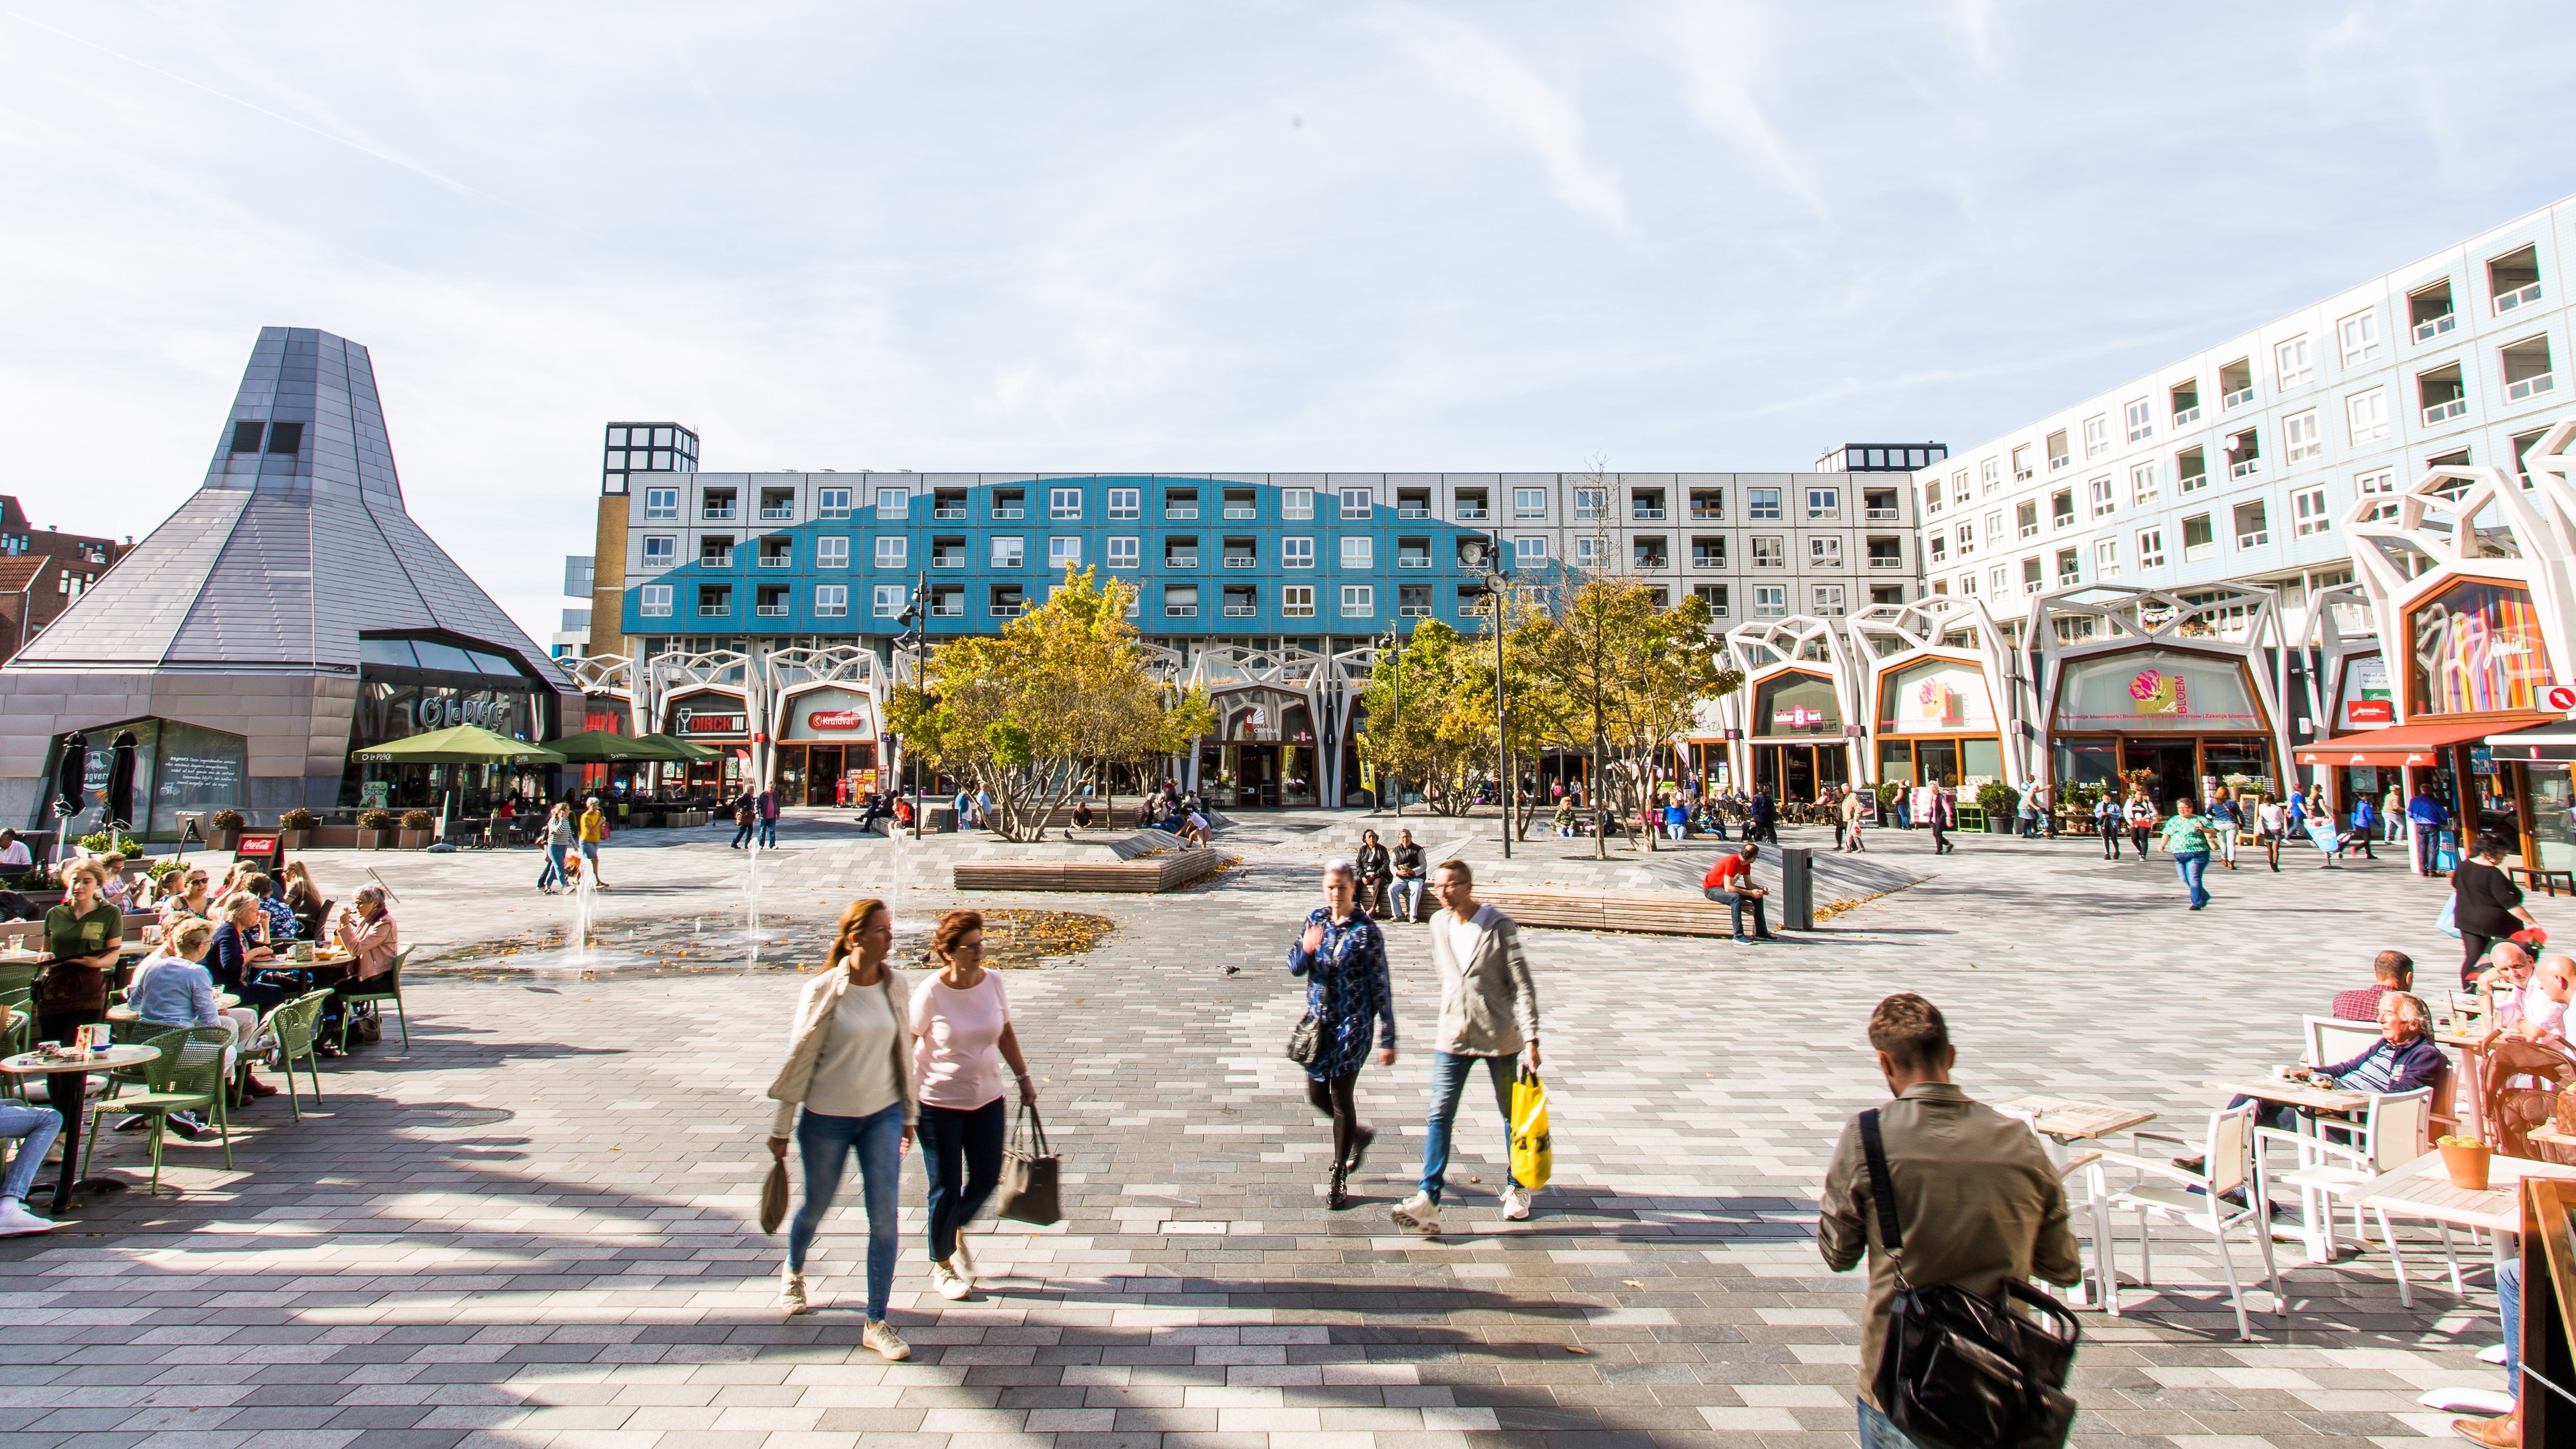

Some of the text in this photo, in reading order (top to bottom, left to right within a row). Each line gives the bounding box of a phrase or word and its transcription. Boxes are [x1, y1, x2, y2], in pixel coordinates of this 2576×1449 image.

[2483, 637, 2534, 670] jamin
[2175, 676, 2187, 714] BLOEM
[443, 699, 503, 732] La PLACE
[822, 716, 854, 725] Kruidvat
